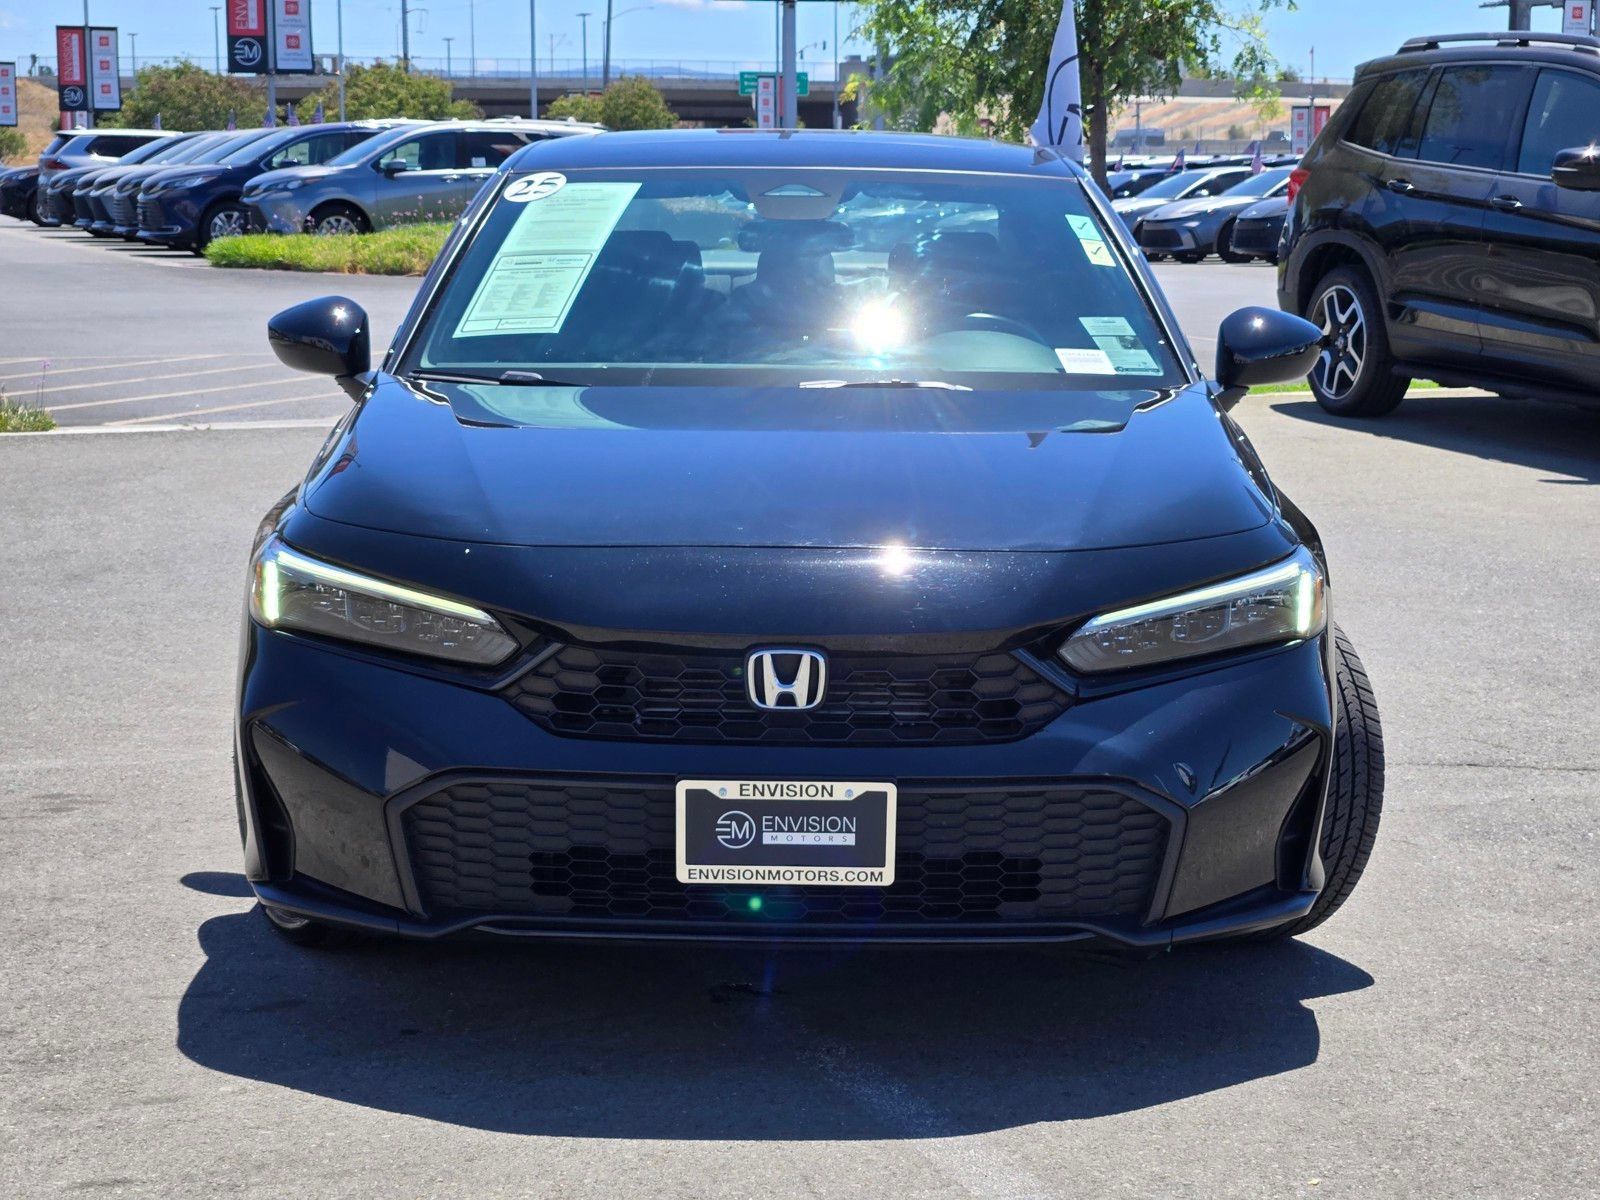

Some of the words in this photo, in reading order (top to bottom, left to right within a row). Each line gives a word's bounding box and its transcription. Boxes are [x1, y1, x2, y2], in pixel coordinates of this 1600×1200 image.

[509, 176, 562, 198] 25
[739, 783, 834, 798] ENVISION
[762, 815, 856, 832] ENVISION
[770, 834, 848, 843] MOTORS
[687, 868, 884, 883] ENVISIONMOTORS.COM
